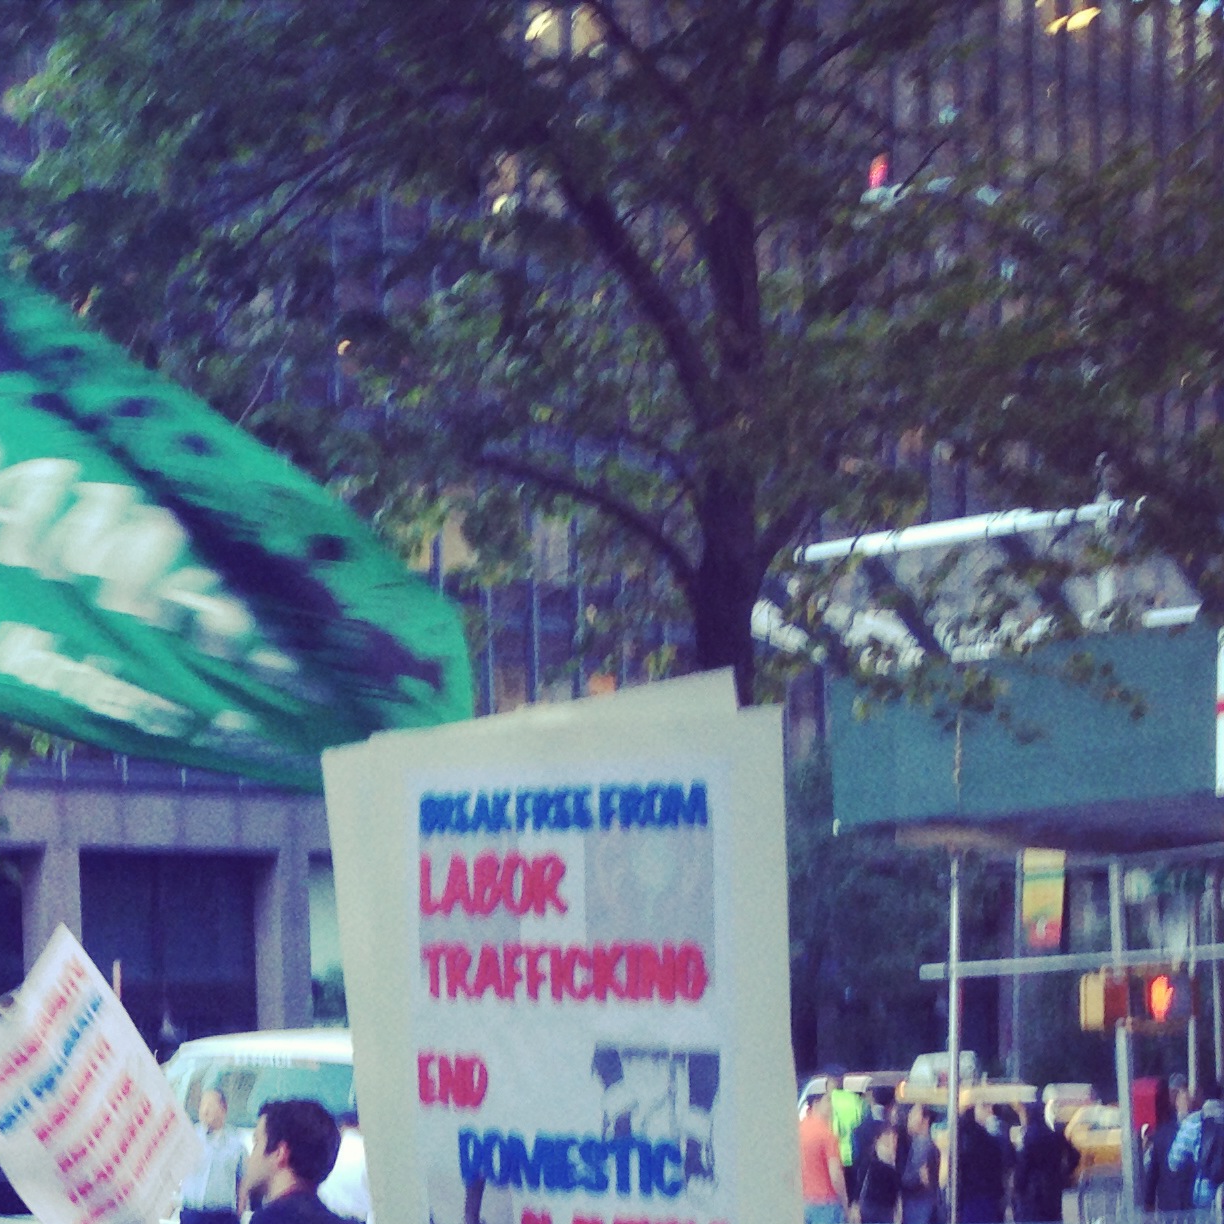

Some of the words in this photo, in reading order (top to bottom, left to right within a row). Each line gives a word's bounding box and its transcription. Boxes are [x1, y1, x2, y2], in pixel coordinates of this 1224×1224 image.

[419, 788, 513, 836] BREAK
[515, 785, 594, 834] FREE
[598, 779, 708, 830] FROM
[418, 848, 568, 918] LABOR
[421, 939, 708, 1004] TRAFFICKING
[417, 1049, 489, 1112] END
[458, 1126, 683, 1200] DOMESTIC
